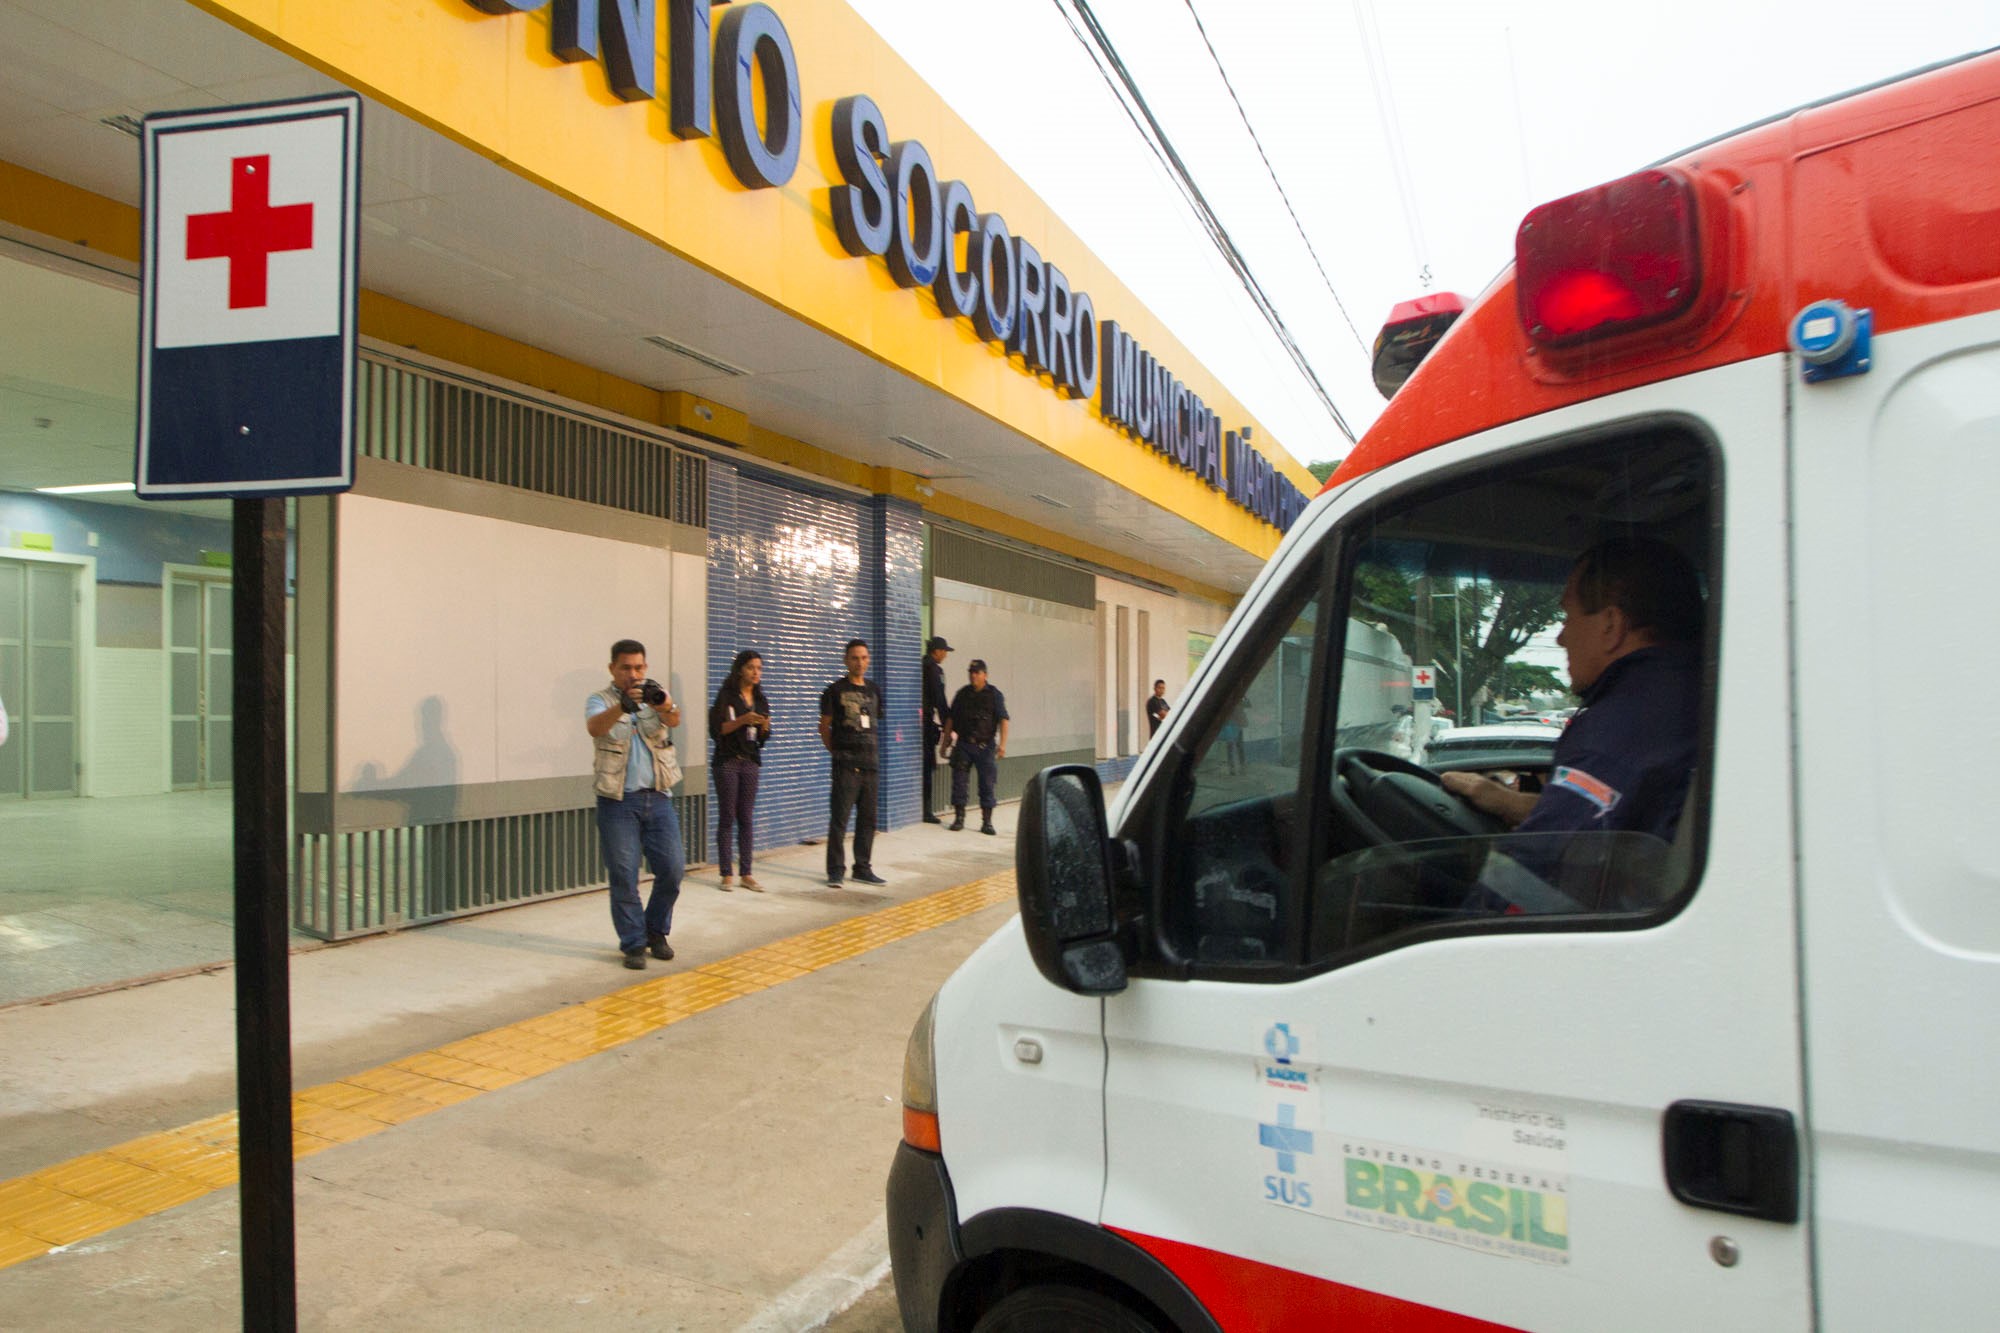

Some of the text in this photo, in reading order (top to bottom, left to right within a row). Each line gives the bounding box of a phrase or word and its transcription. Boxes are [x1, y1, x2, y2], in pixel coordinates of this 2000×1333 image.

[829, 94, 1098, 399] SOCORRO
[1101, 320, 1228, 494] MUNICIPAL
[1263, 1175, 1313, 1209] SUS
[1343, 1143, 1567, 1194] GOVERNO FEDERAL
[1344, 1157, 1569, 1251] BRASIL
